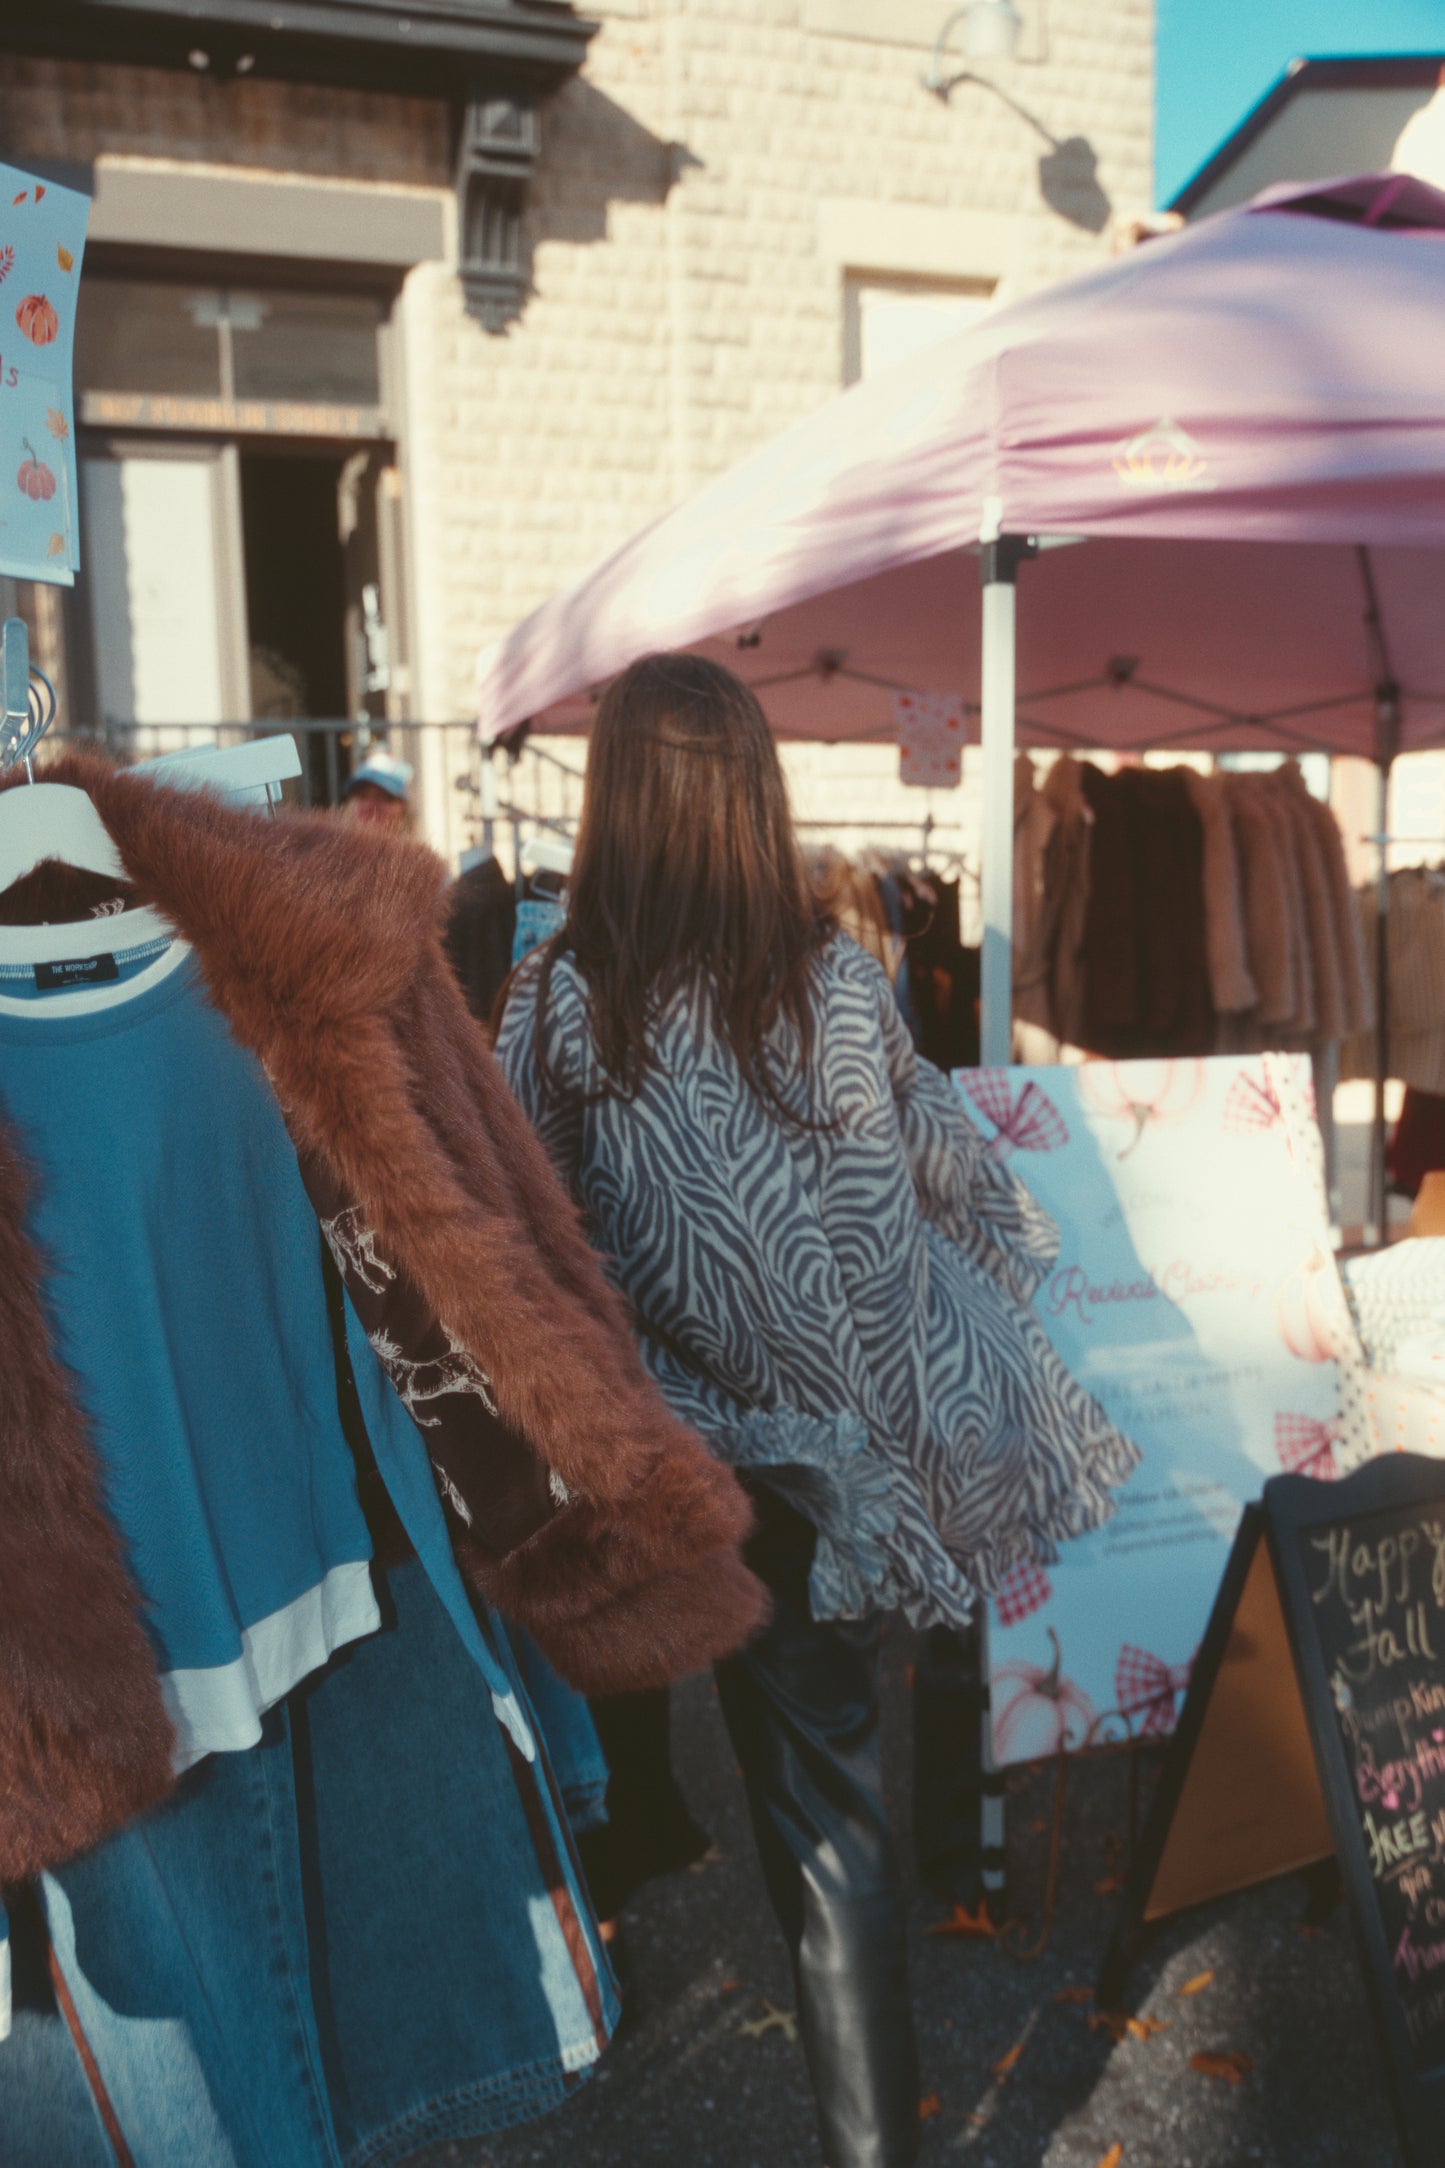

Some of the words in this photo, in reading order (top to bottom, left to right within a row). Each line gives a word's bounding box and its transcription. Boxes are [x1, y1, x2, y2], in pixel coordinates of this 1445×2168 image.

[52, 964, 63, 974] THE
[1311, 1520, 1445, 1617] Happy
[1336, 1596, 1440, 1684] Fall
[1363, 1808, 1430, 1878] FREE
